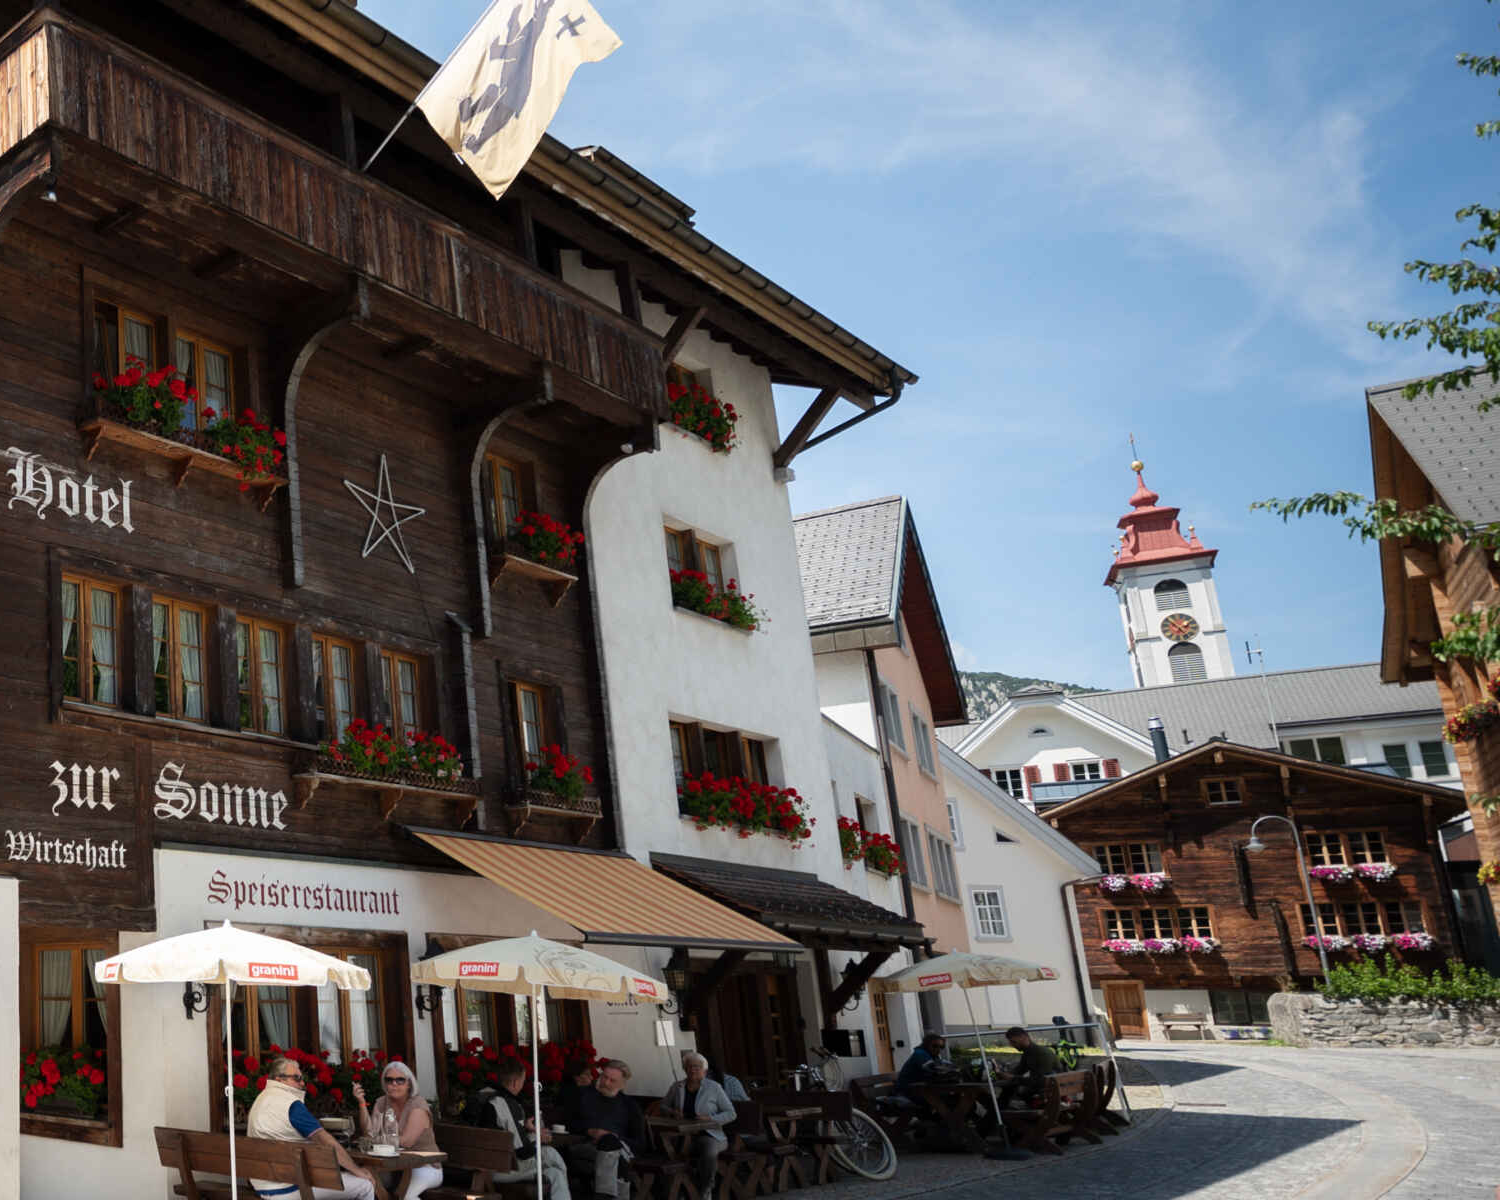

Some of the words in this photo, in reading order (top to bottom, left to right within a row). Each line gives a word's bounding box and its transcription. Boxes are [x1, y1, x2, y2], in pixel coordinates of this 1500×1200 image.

[5, 446, 136, 534] Hotel
[48, 759, 121, 817] zur
[153, 761, 289, 832] Sonne
[6, 828, 127, 871] Wirtschaft
[206, 870, 402, 917] Speiserestaurant
[252, 964, 295, 978] granini
[461, 962, 498, 975] granini
